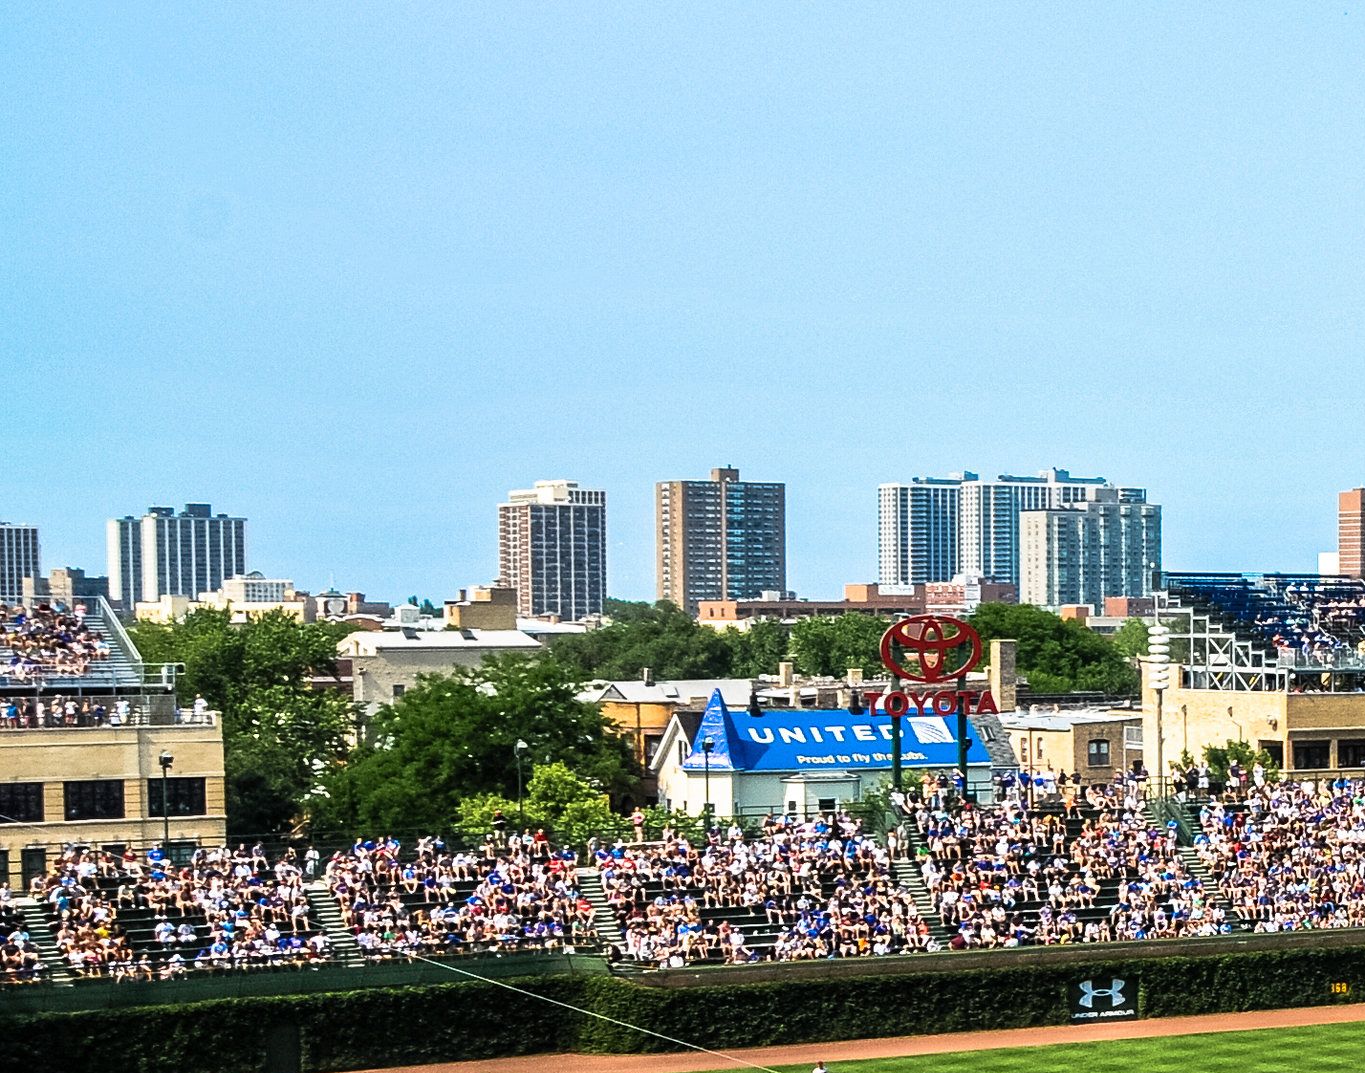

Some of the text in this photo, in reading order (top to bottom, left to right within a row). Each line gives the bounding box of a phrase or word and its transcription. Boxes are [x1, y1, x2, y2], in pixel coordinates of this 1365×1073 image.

[863, 690, 1000, 717] TOYOTA
[747, 724, 904, 744] UNITED
[796, 751, 835, 765] Proud
[837, 752, 851, 763] to
[852, 752, 870, 765] fly
[871, 752, 892, 763] the
